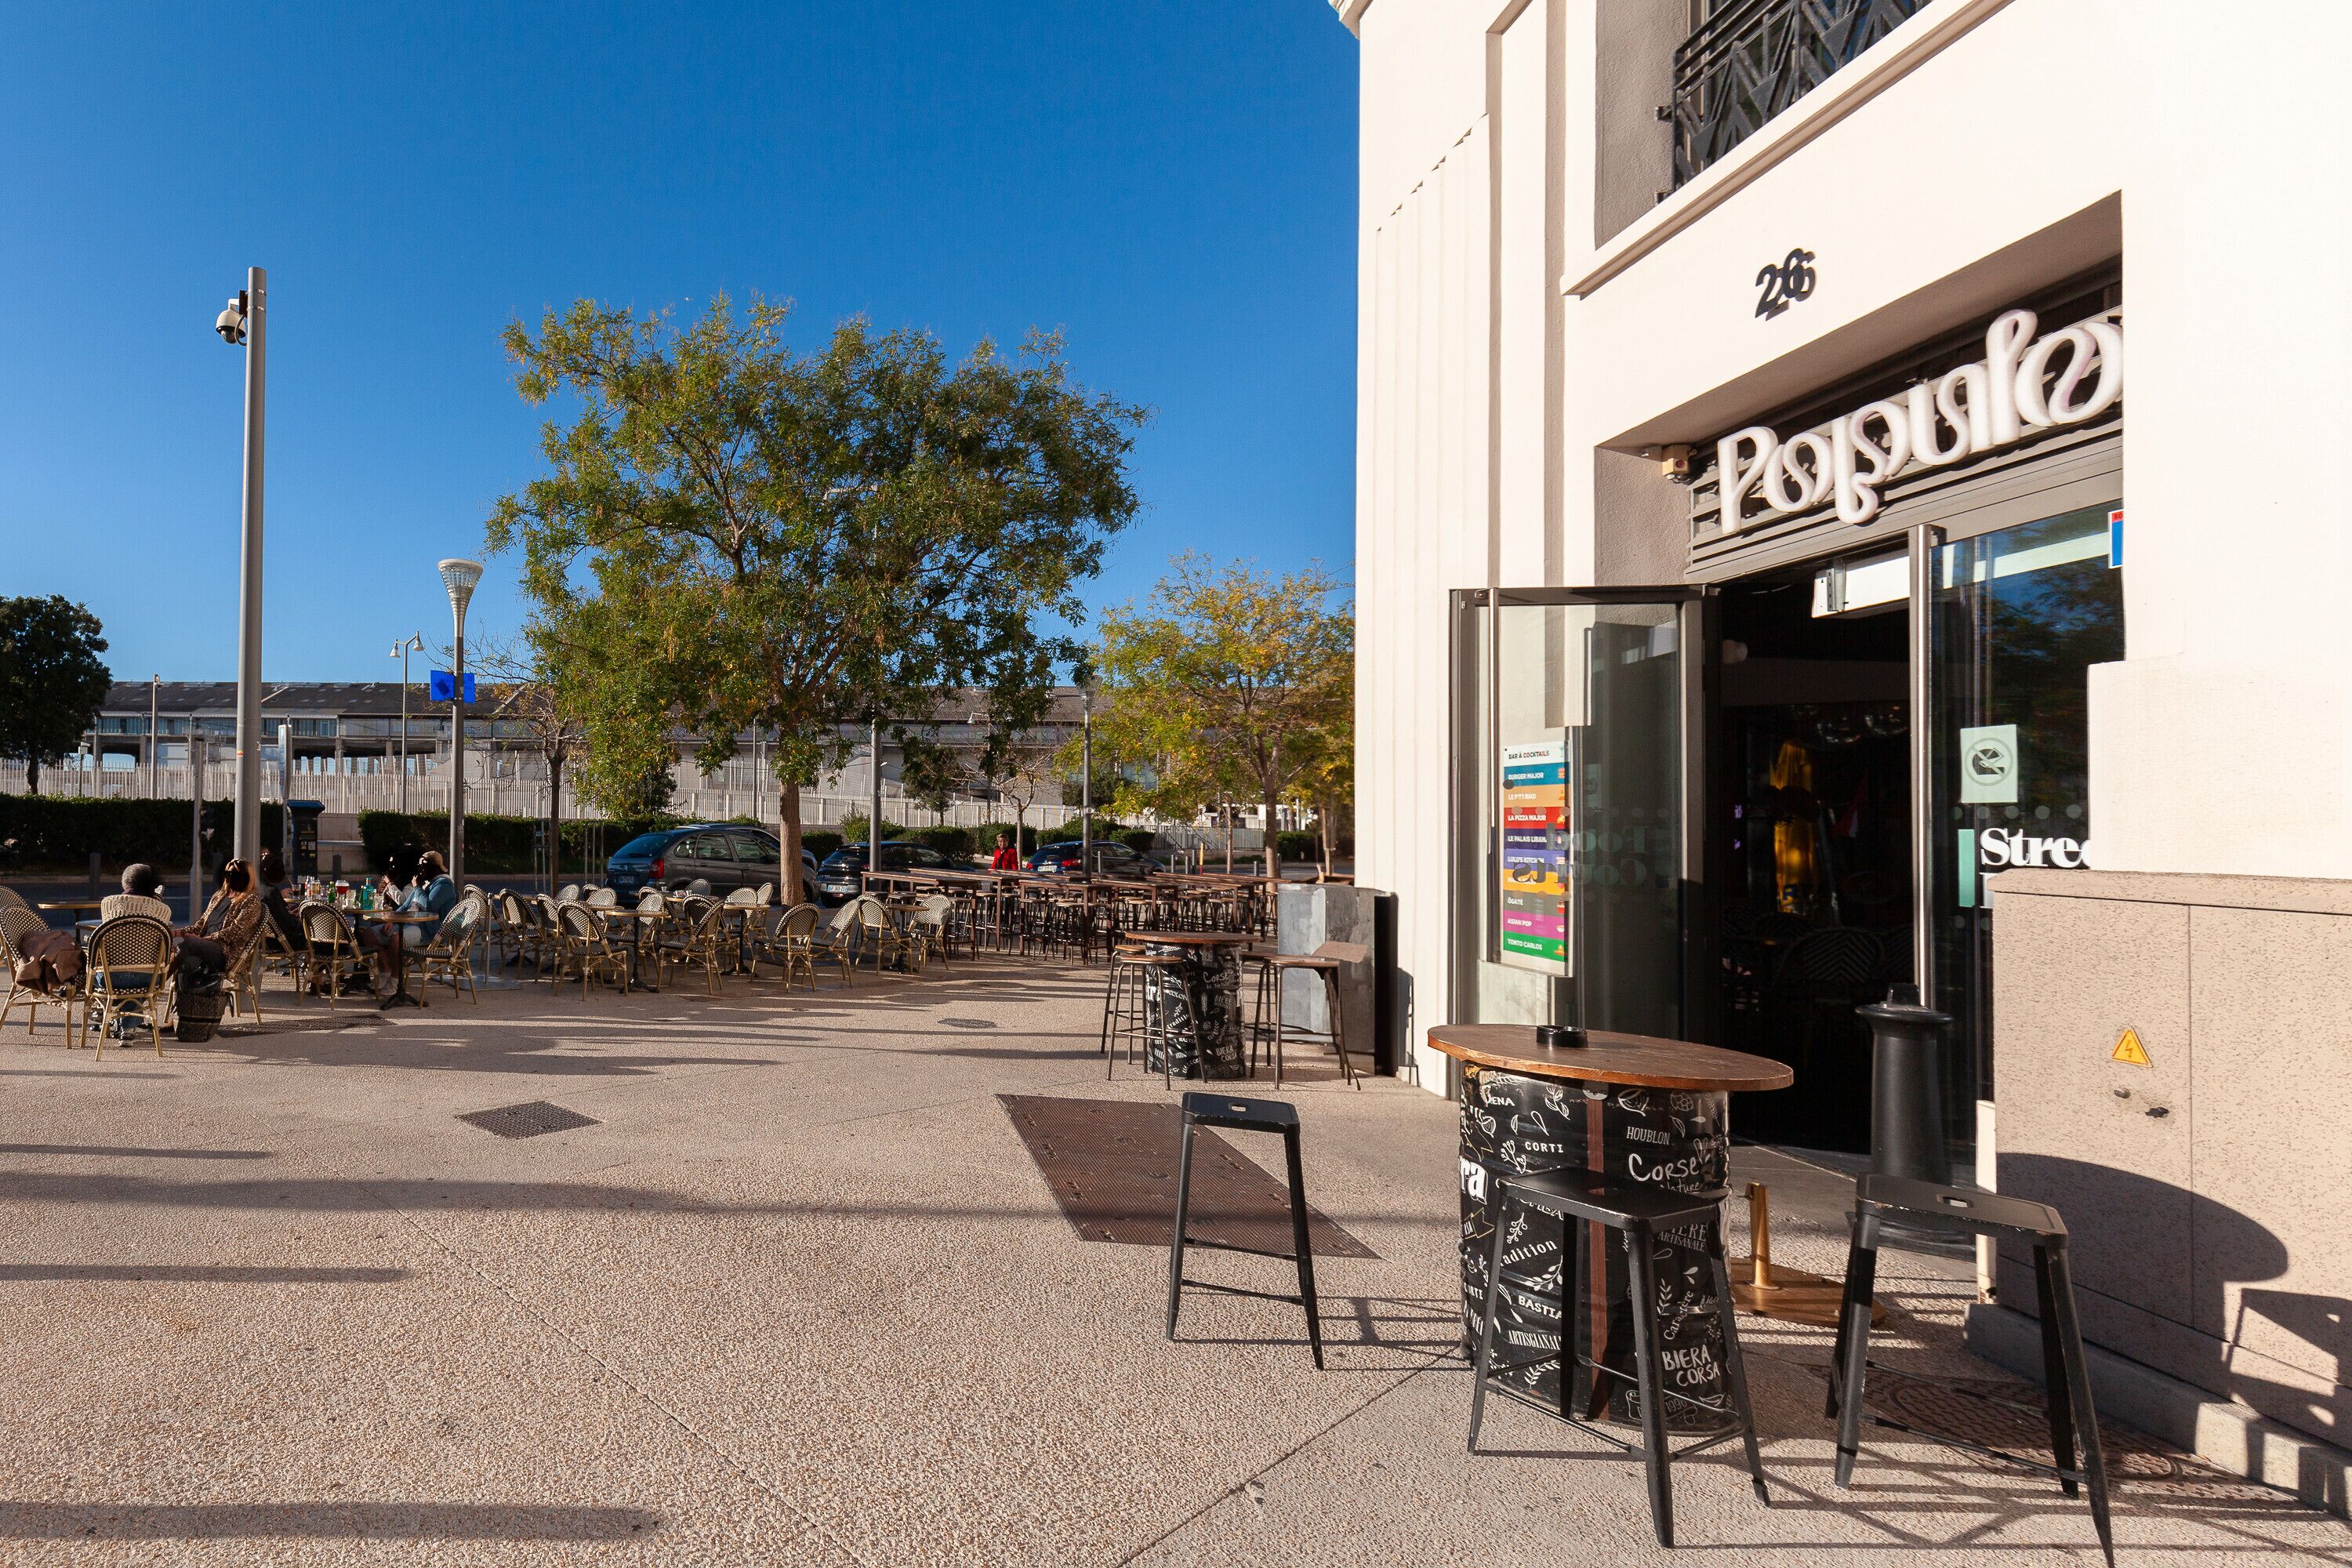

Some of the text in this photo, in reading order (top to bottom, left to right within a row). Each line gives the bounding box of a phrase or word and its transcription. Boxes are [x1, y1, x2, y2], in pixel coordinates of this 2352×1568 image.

[1755, 248, 1805, 318] 26
[1508, 918, 1523, 927] ASIAN
[1508, 938, 1543, 950] TONTO CARLOS
[1626, 1126, 1670, 1145] HOUBLON
[1525, 1142, 1564, 1153] CORTI
[1657, 1231, 1707, 1252] ARTISANALE
[1664, 1290, 1694, 1341] Caractère
[1661, 1345, 1711, 1370] BIERA
[1676, 1362, 1720, 1387] CORSA
